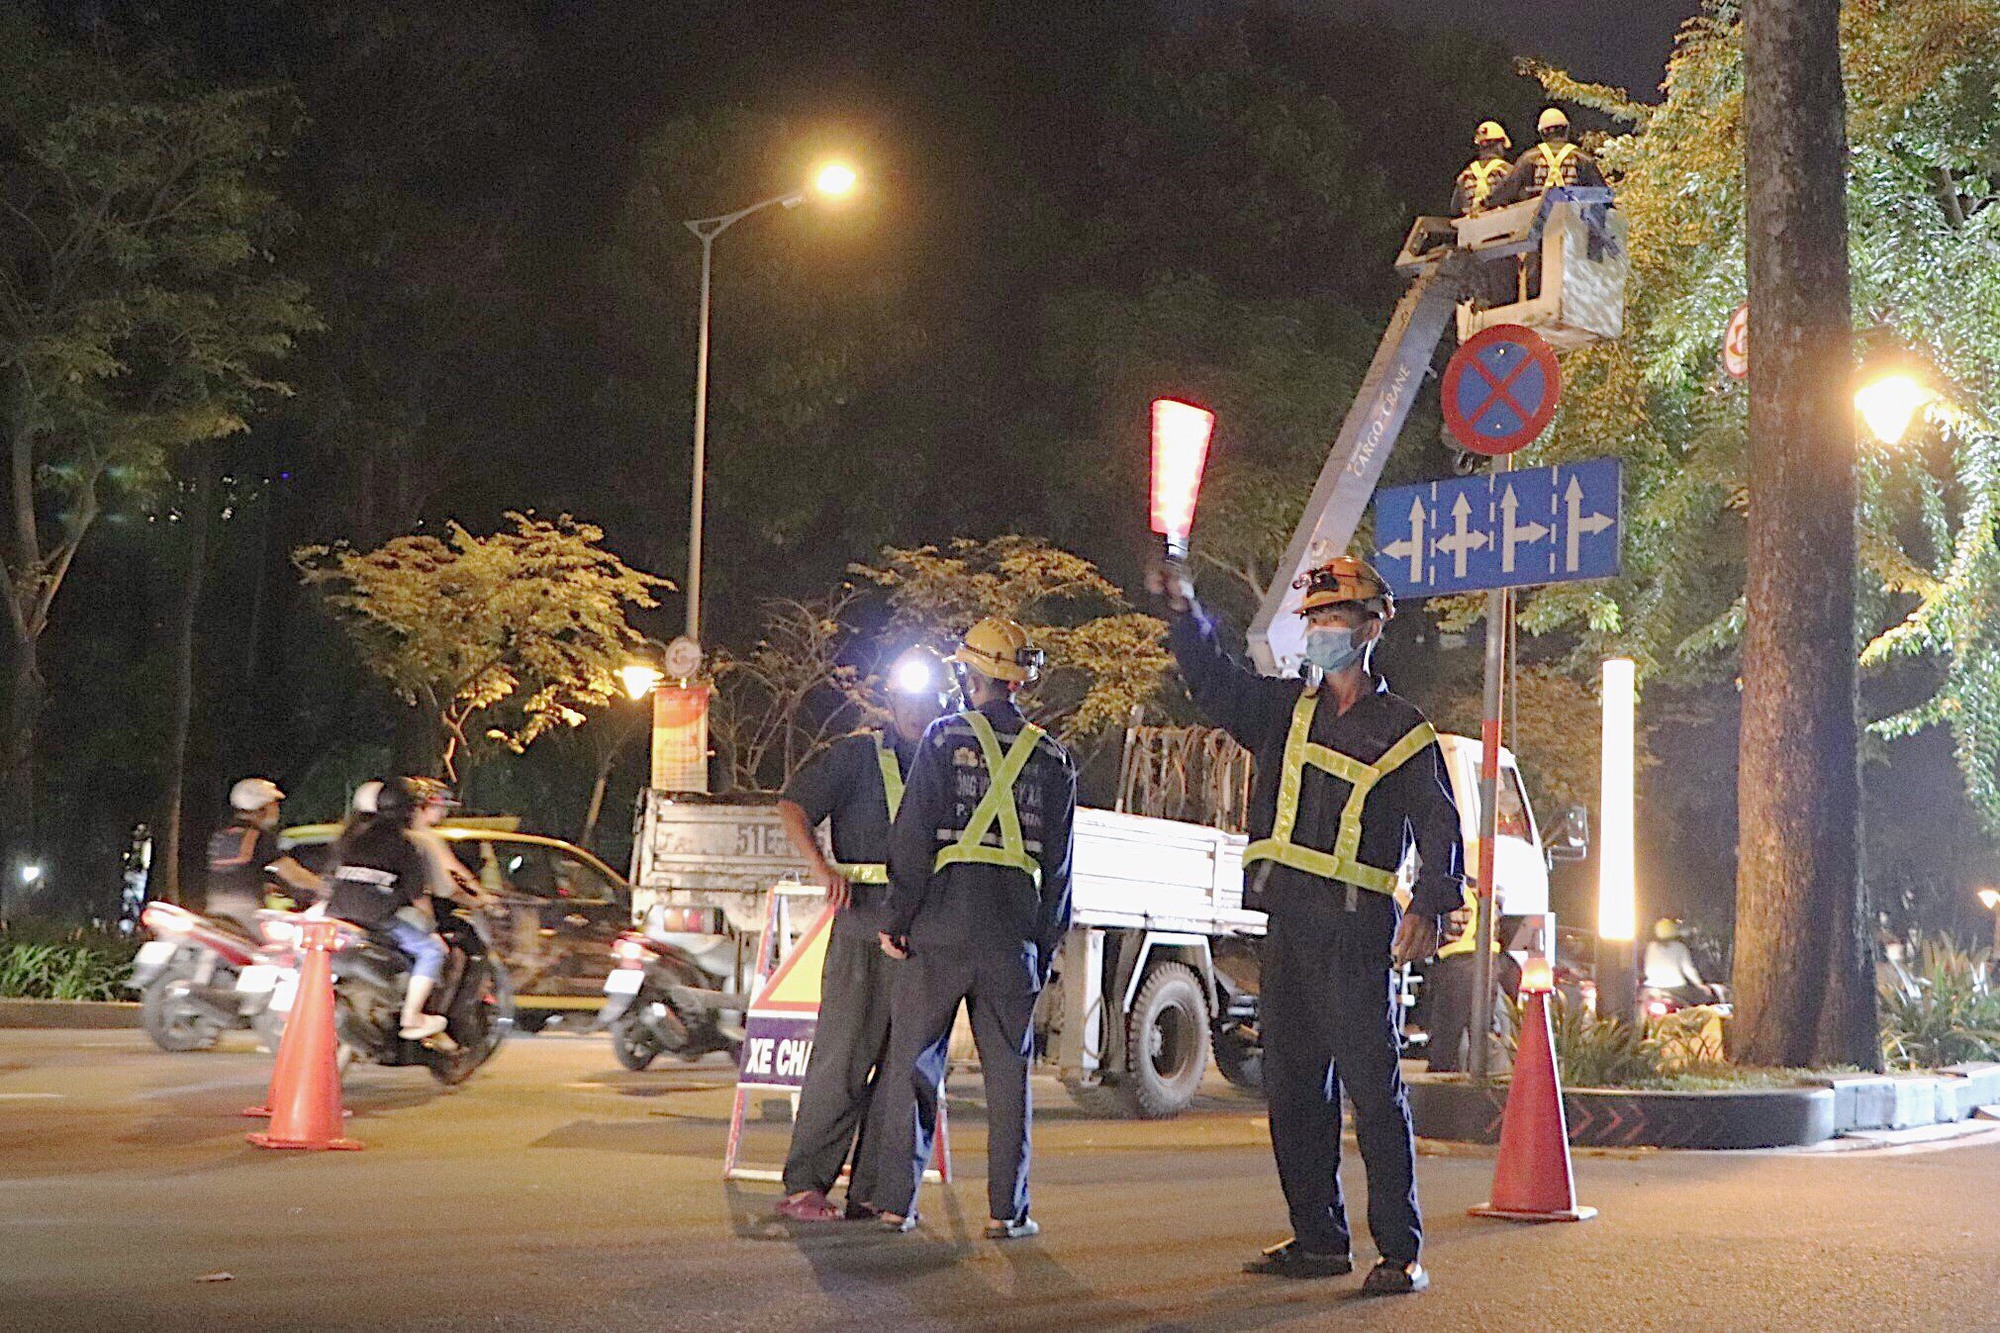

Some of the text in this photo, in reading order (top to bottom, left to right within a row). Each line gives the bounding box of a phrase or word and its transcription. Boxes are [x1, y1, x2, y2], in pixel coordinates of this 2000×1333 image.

[1353, 421, 1384, 477] CARGO
[1382, 365, 1411, 416] CRANE
[745, 1038, 775, 1074] XE
